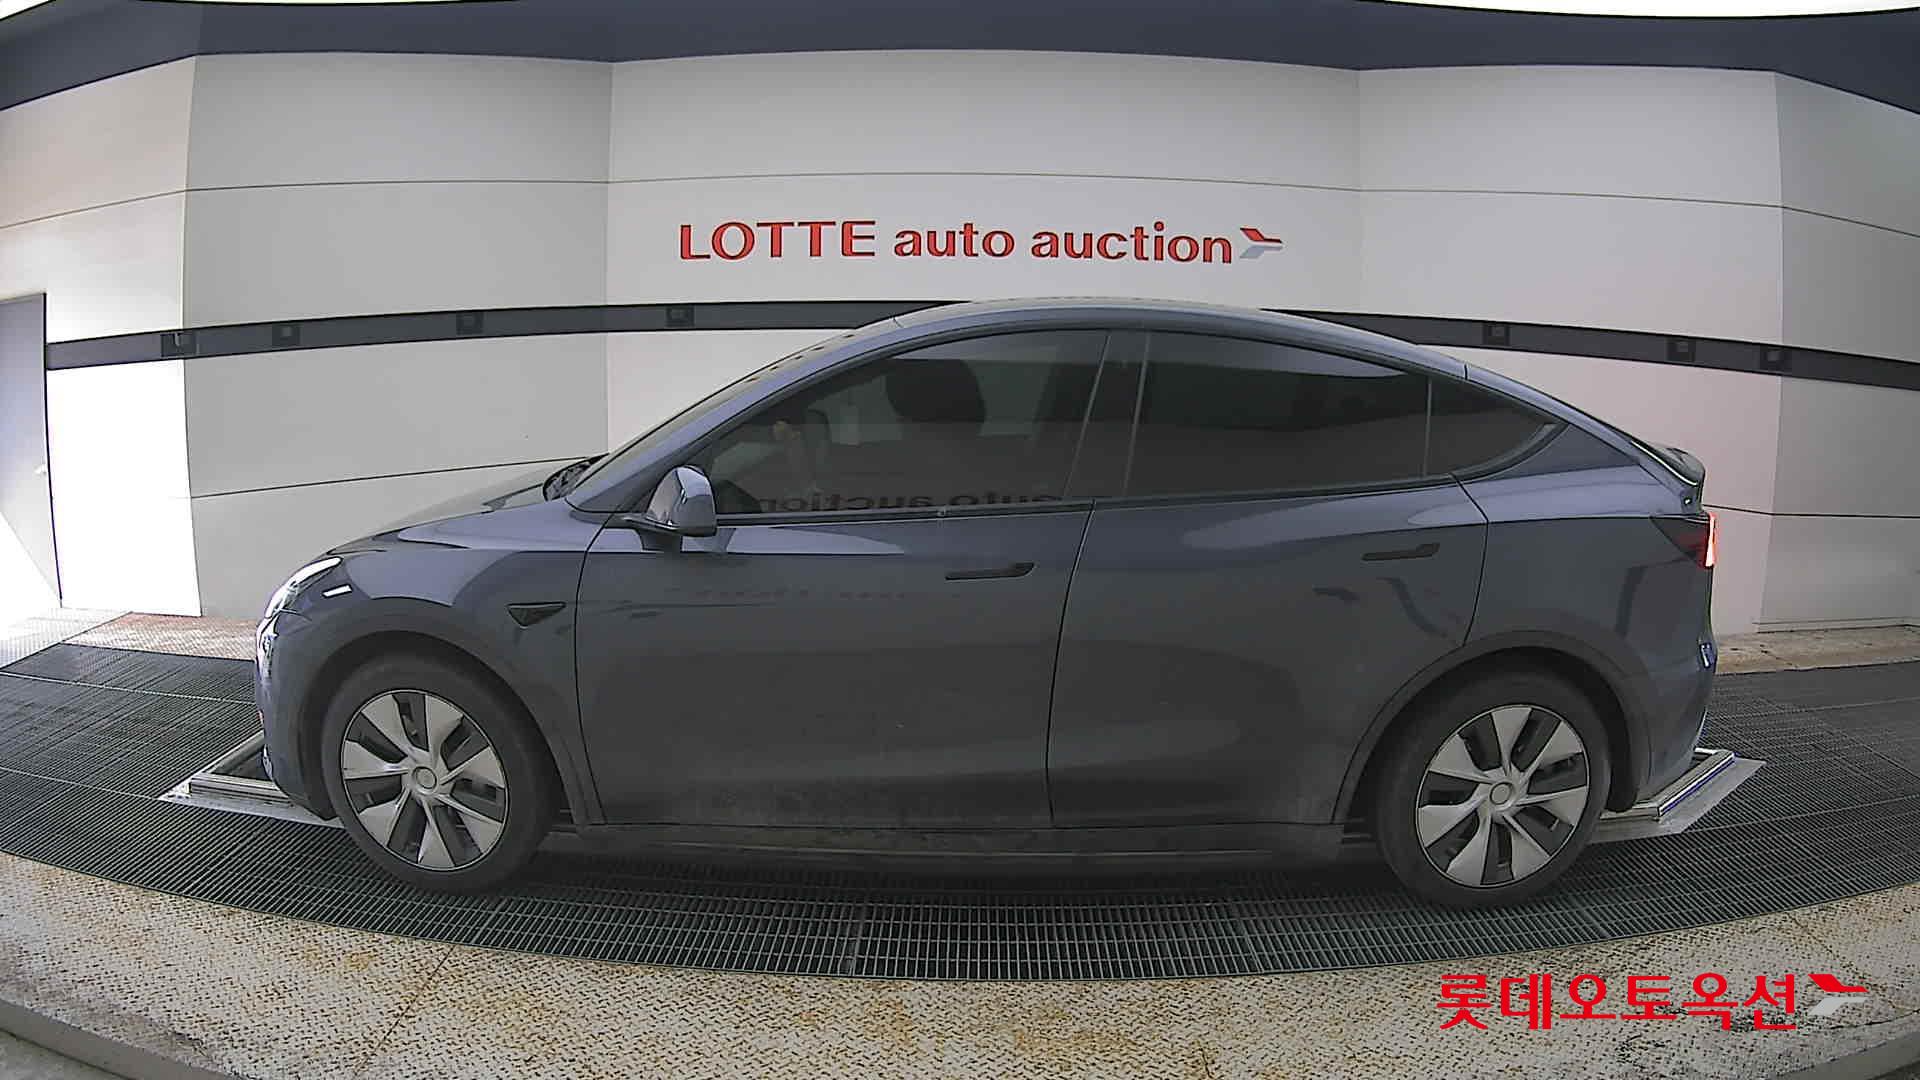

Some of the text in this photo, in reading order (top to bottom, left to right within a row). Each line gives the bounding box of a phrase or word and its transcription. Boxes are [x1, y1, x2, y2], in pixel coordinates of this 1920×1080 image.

[680, 220, 1232, 263] LOTTE auto auction
